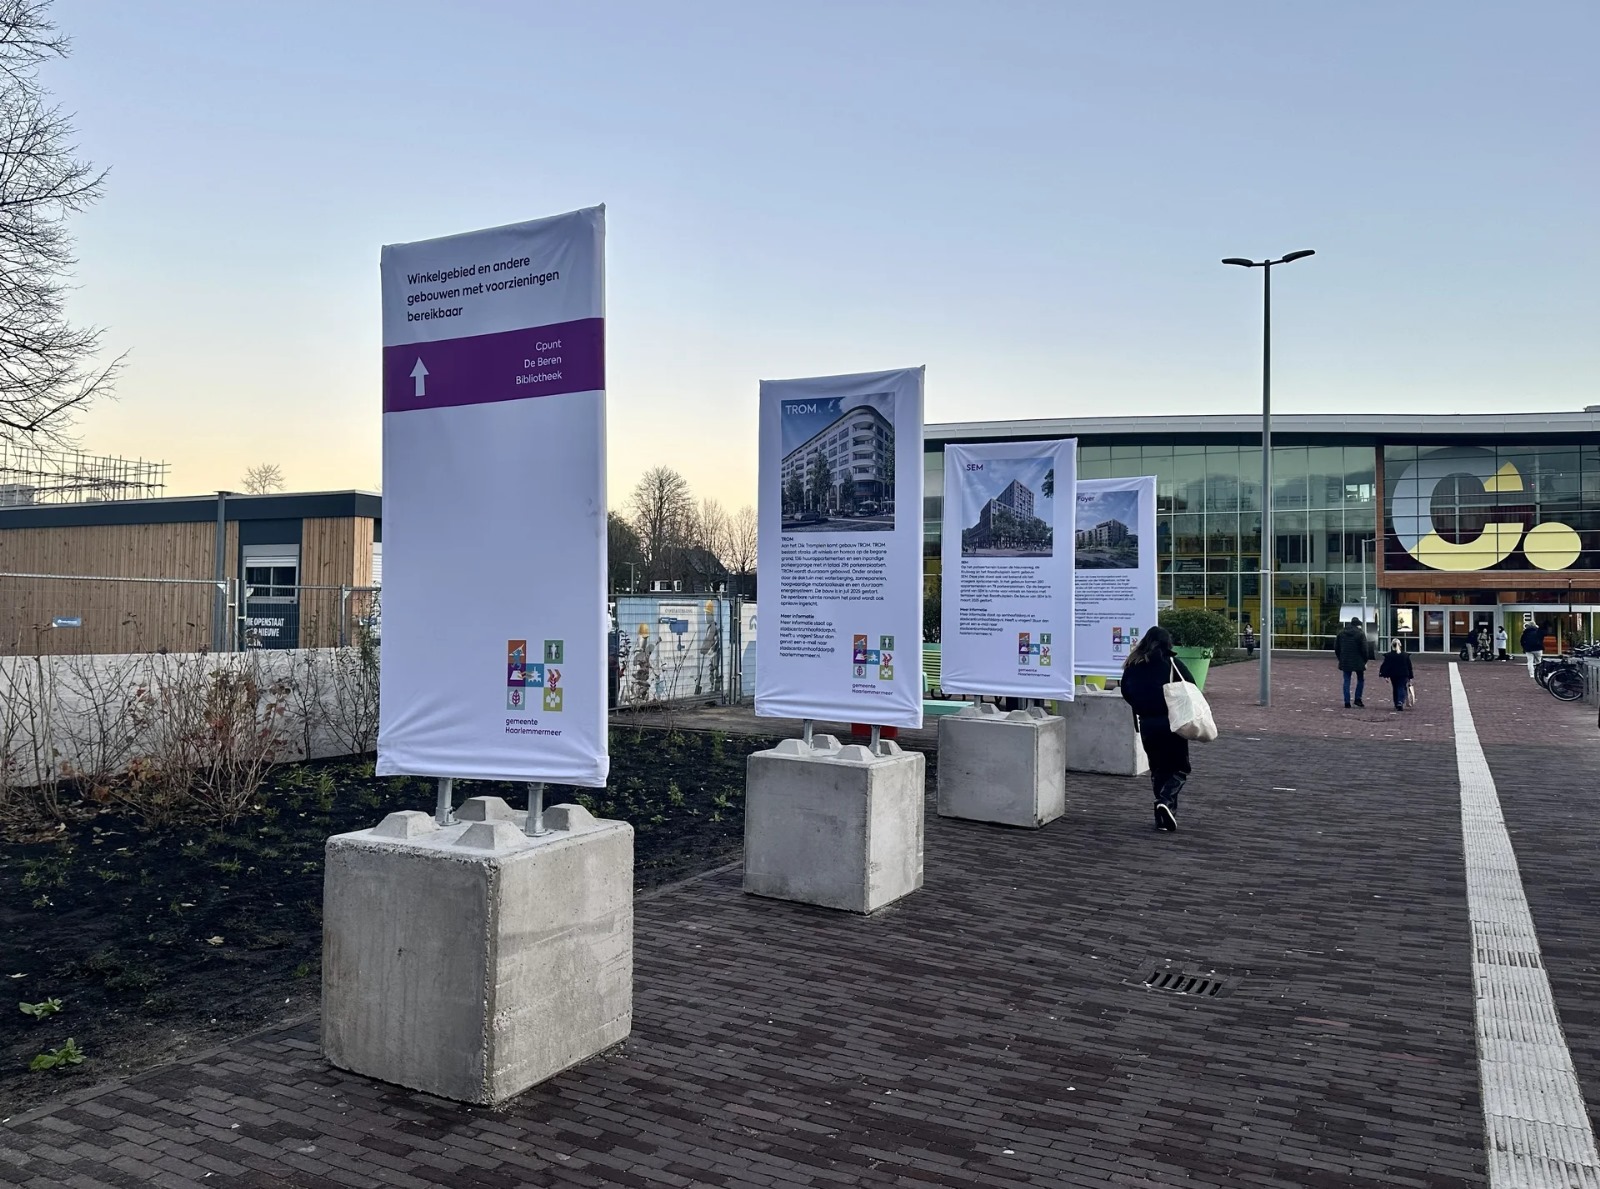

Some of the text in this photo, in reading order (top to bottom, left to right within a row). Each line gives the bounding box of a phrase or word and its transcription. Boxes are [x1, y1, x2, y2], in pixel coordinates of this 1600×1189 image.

[407, 256, 530, 285] Winkelgebied en andere
[407, 270, 560, 306] gebouwen met voorzieningen
[407, 305, 463, 322] bereikbaar
[535, 339, 561, 352] Cpunt
[524, 356, 561, 368] De Beren
[516, 371, 562, 384] Bibliotheek
[785, 404, 817, 415] TROM
[254, 618, 284, 627] OPENSTAAT
[505, 726, 562, 736] Haarlemmermeer
